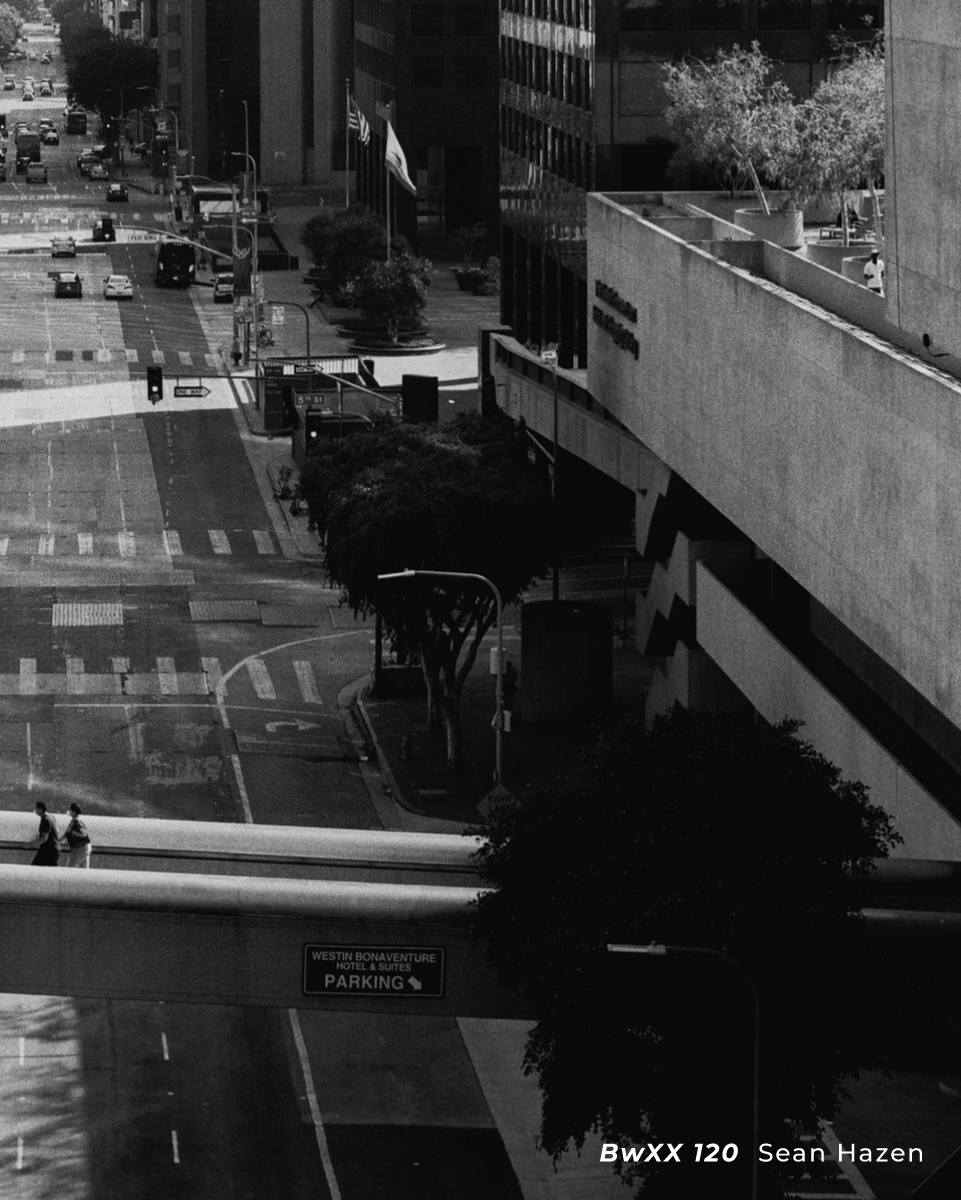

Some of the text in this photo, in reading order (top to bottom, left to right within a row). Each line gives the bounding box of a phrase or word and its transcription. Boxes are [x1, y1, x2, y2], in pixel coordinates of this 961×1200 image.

[488, 794, 512, 803] RIGHT
[312, 951, 436, 963] WESTIN BONAVENTURE
[336, 962, 411, 972] HOTEL & SUITES
[325, 974, 404, 990] PARKING
